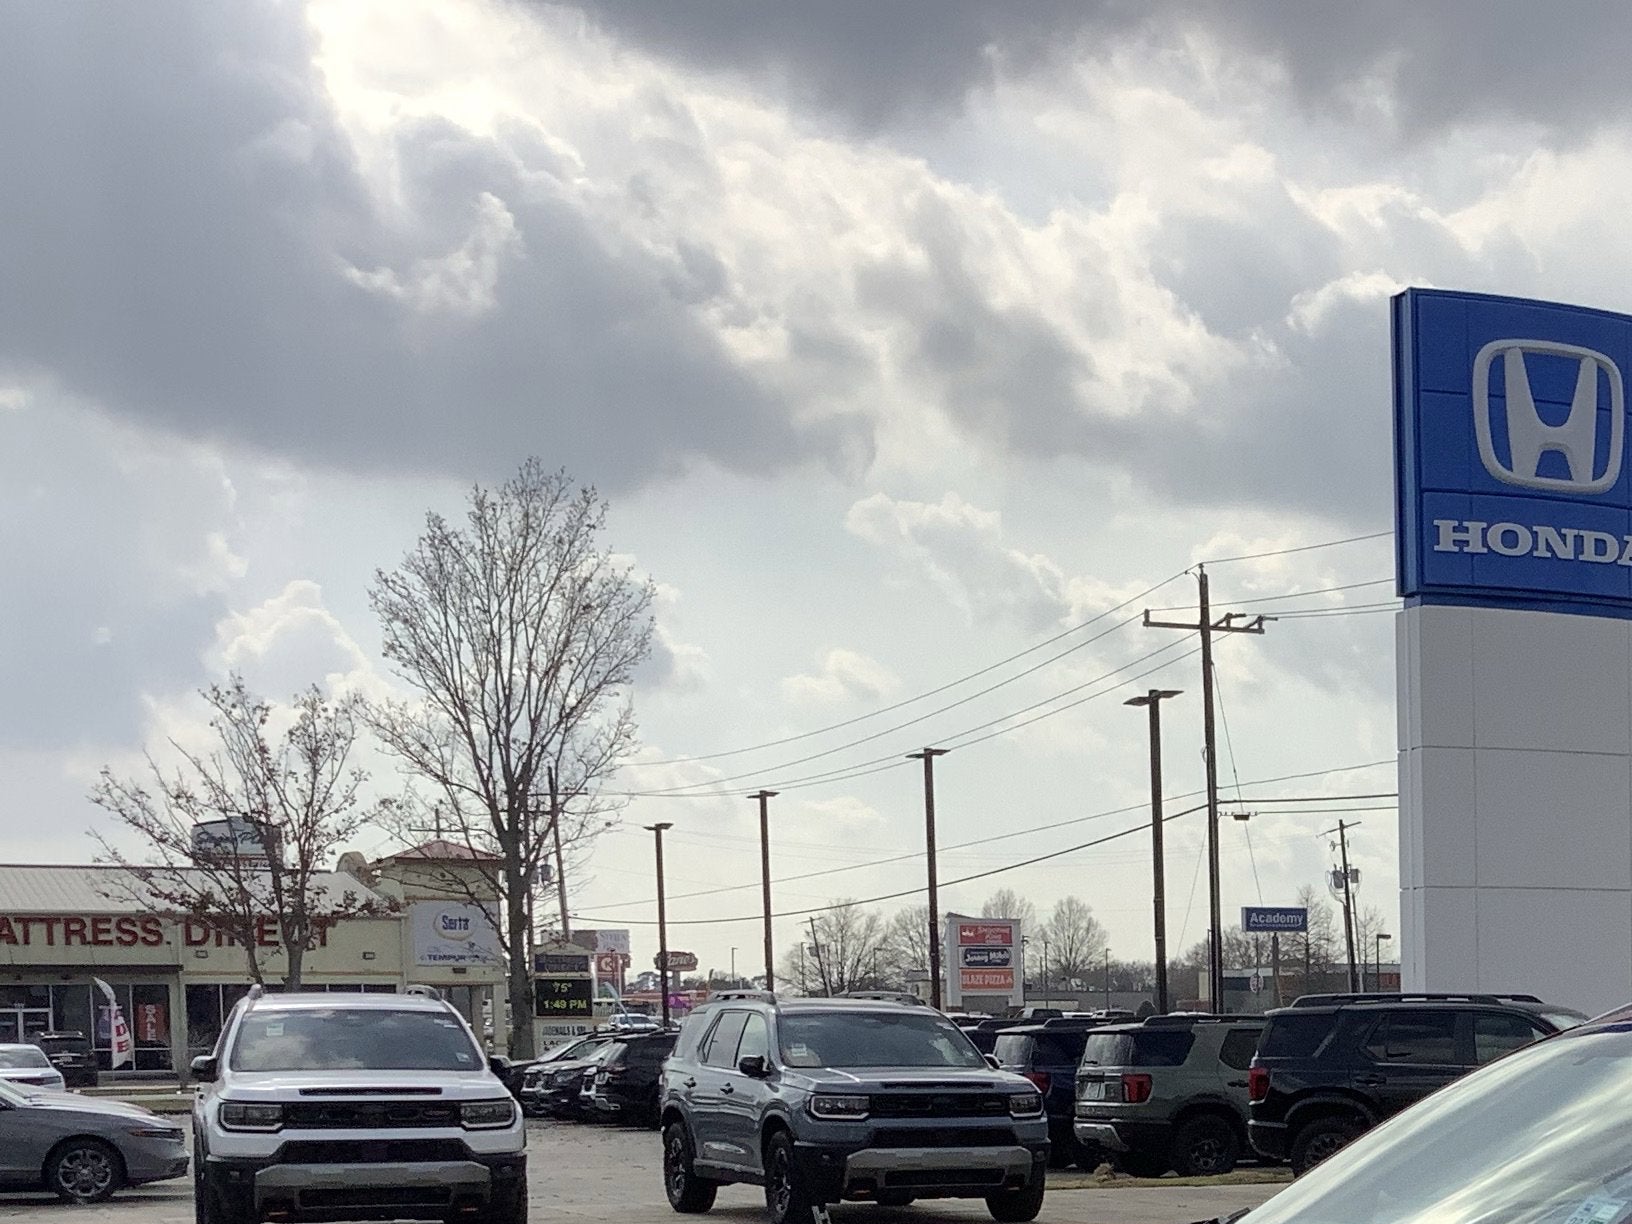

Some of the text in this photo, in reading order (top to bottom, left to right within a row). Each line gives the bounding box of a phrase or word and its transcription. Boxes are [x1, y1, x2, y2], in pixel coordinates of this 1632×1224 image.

[442, 915, 469, 930] Serta
[1250, 912, 1304, 926] Academy
[185, 914, 336, 947] DIET
[569, 1000, 587, 1009] PM
[145, 1005, 156, 1040] SALE
